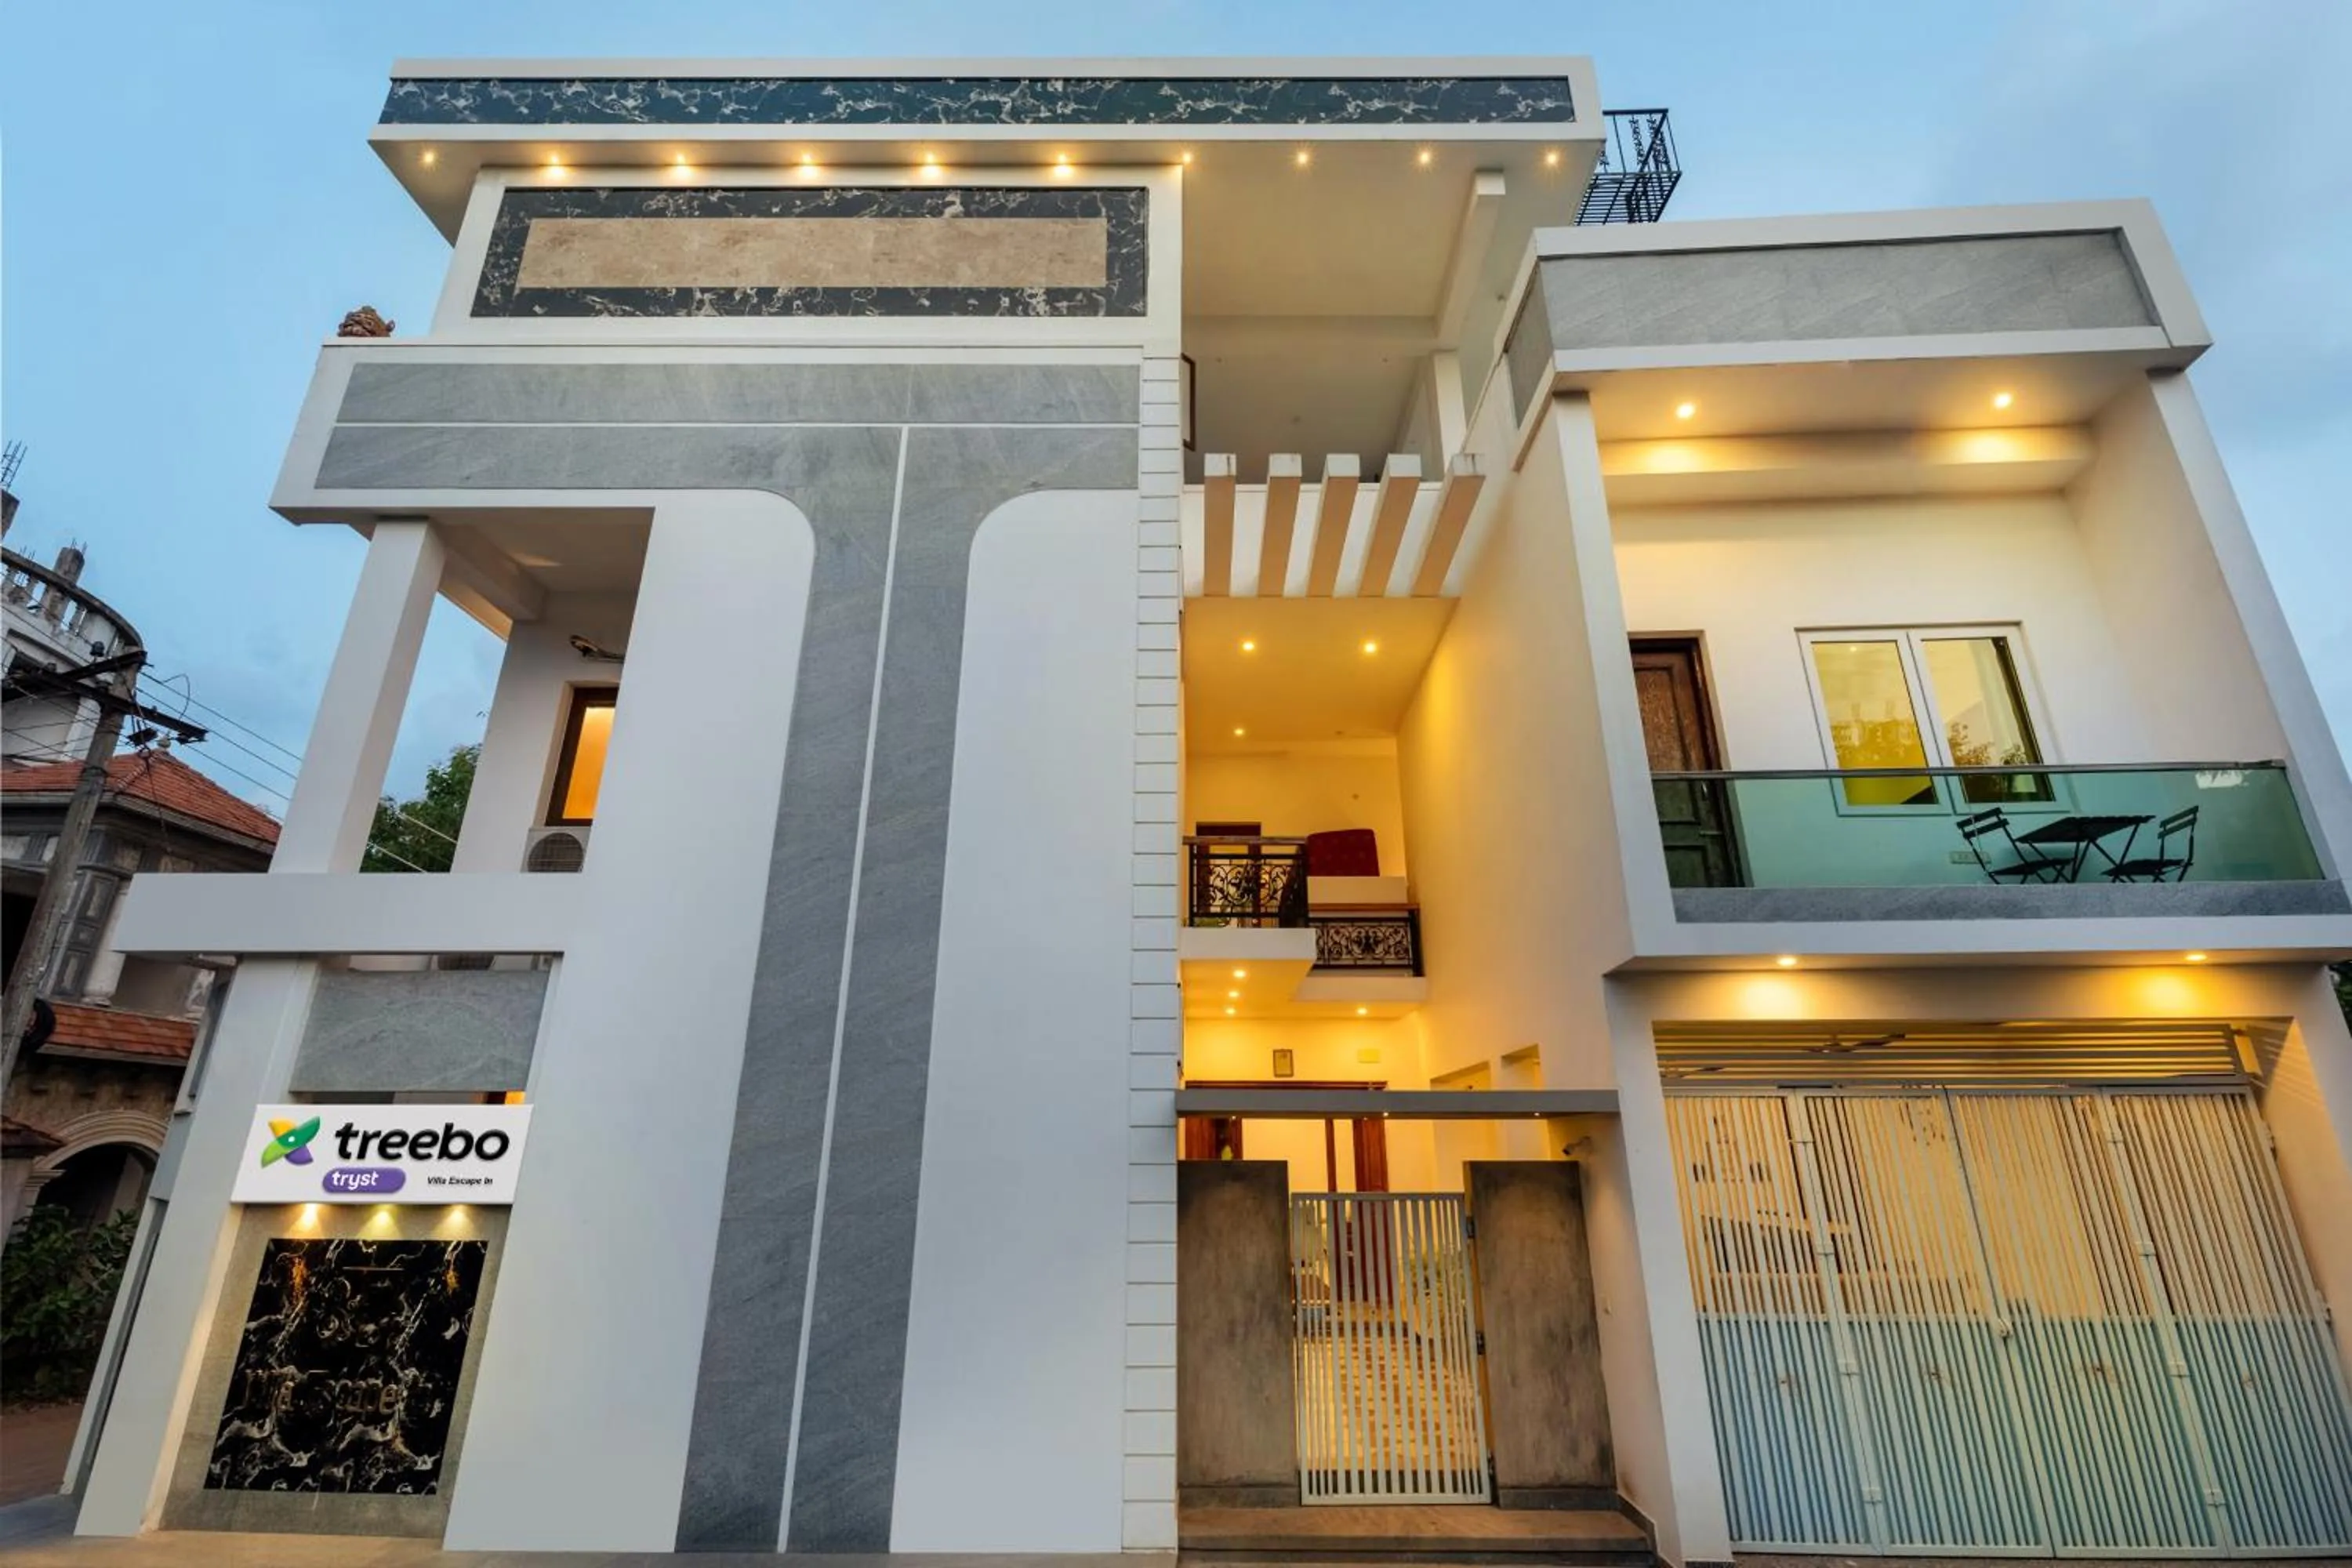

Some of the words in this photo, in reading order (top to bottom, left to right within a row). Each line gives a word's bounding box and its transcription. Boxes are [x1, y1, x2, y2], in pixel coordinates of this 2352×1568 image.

[335, 1122, 510, 1160] treebo
[332, 1171, 378, 1190] tryst
[427, 1176, 446, 1185] Villa
[448, 1177, 482, 1186] Escape
